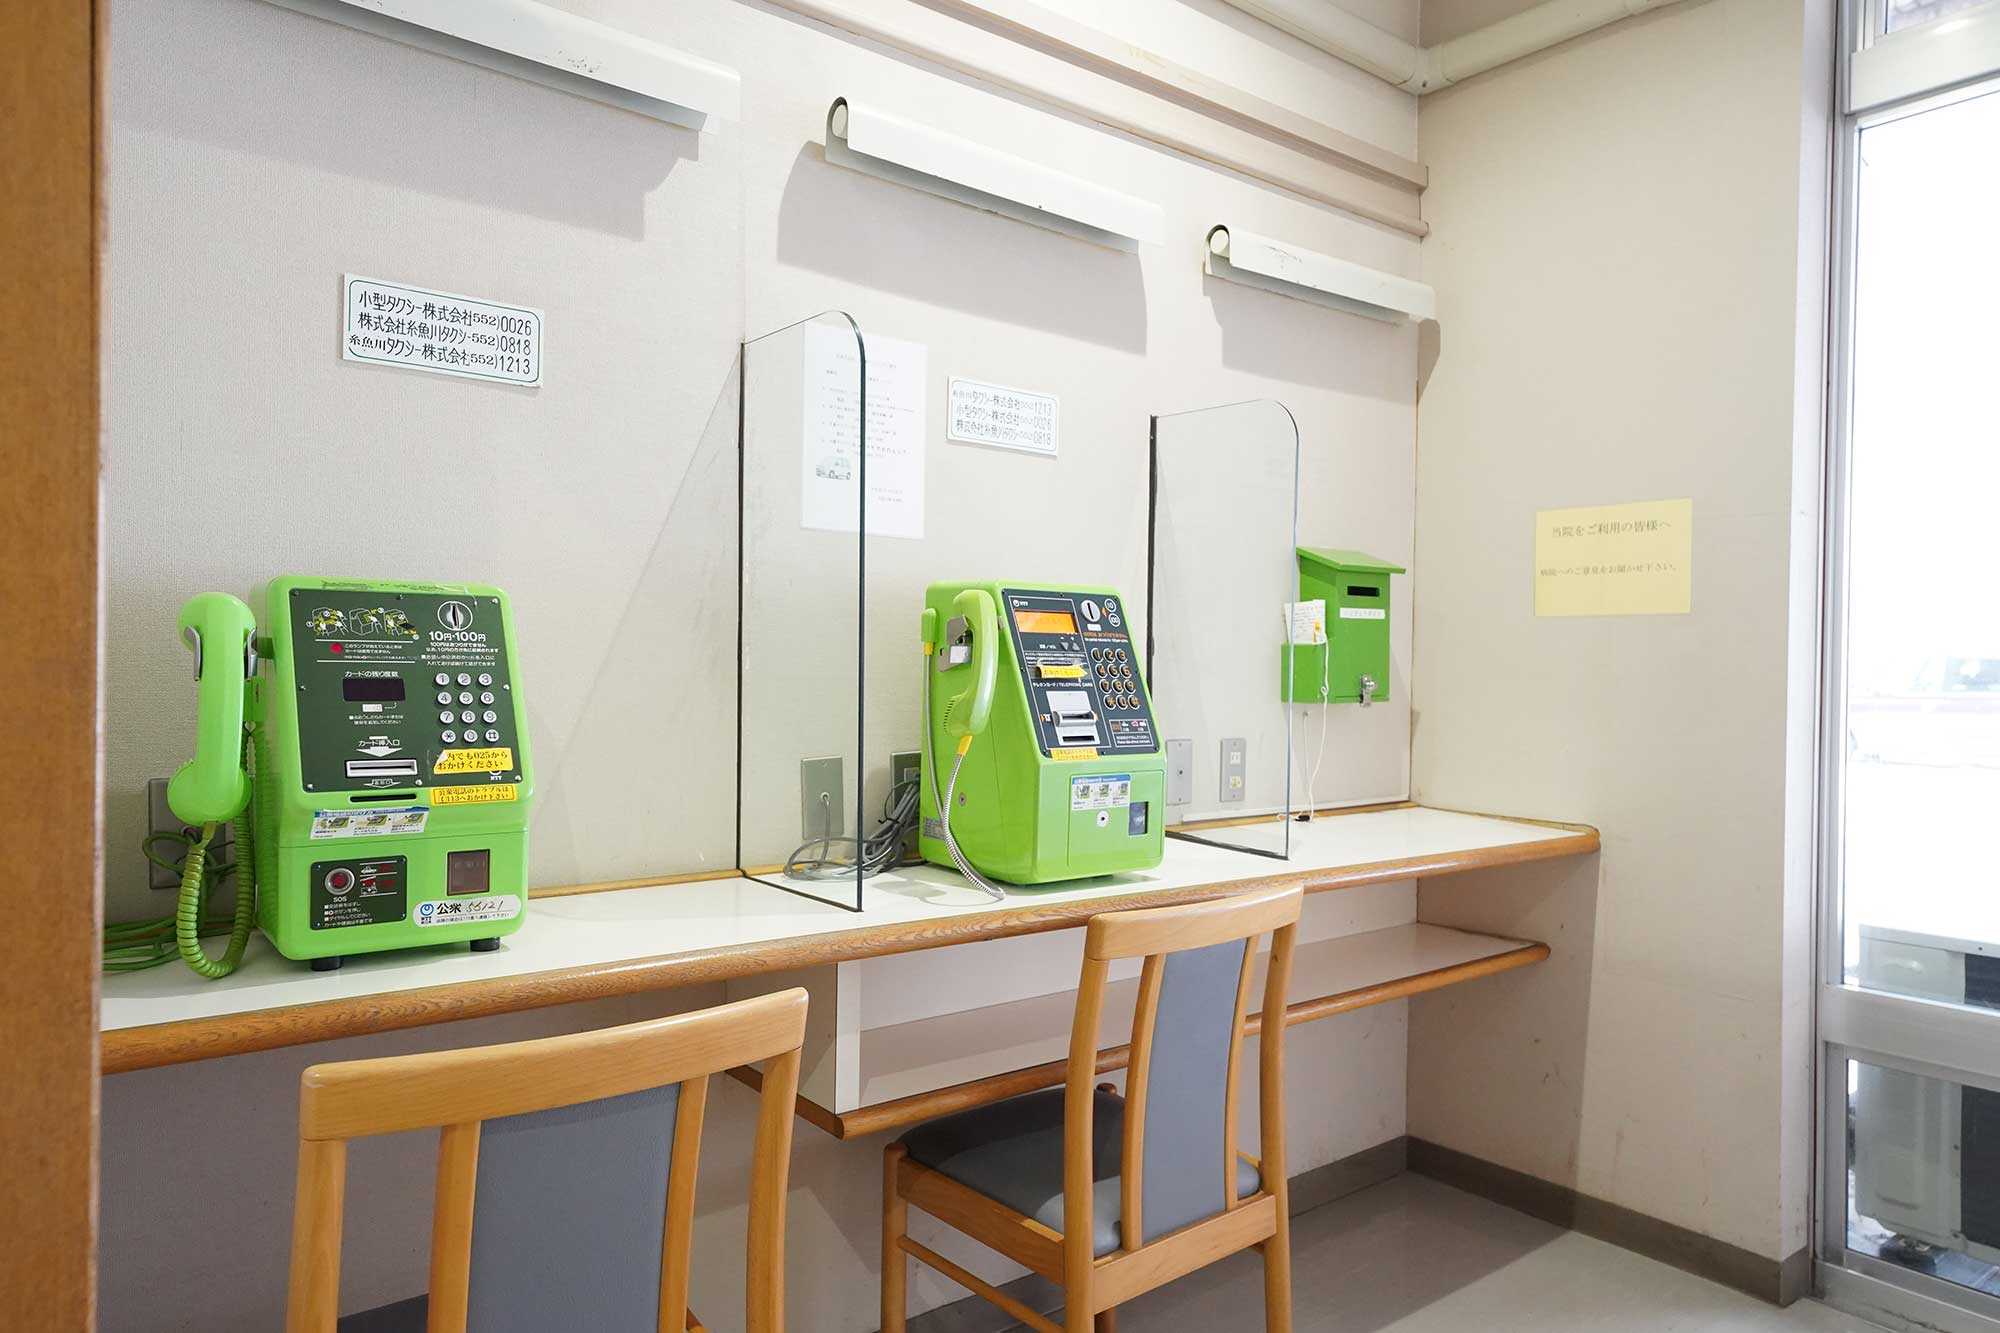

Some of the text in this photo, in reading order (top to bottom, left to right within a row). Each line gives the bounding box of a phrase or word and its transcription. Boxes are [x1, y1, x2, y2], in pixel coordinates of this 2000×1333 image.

[1552, 519, 1672, 537] 当院をご利用の皆様へ
[437, 760, 503, 770] おかけください
[437, 902, 461, 915] 公衆
